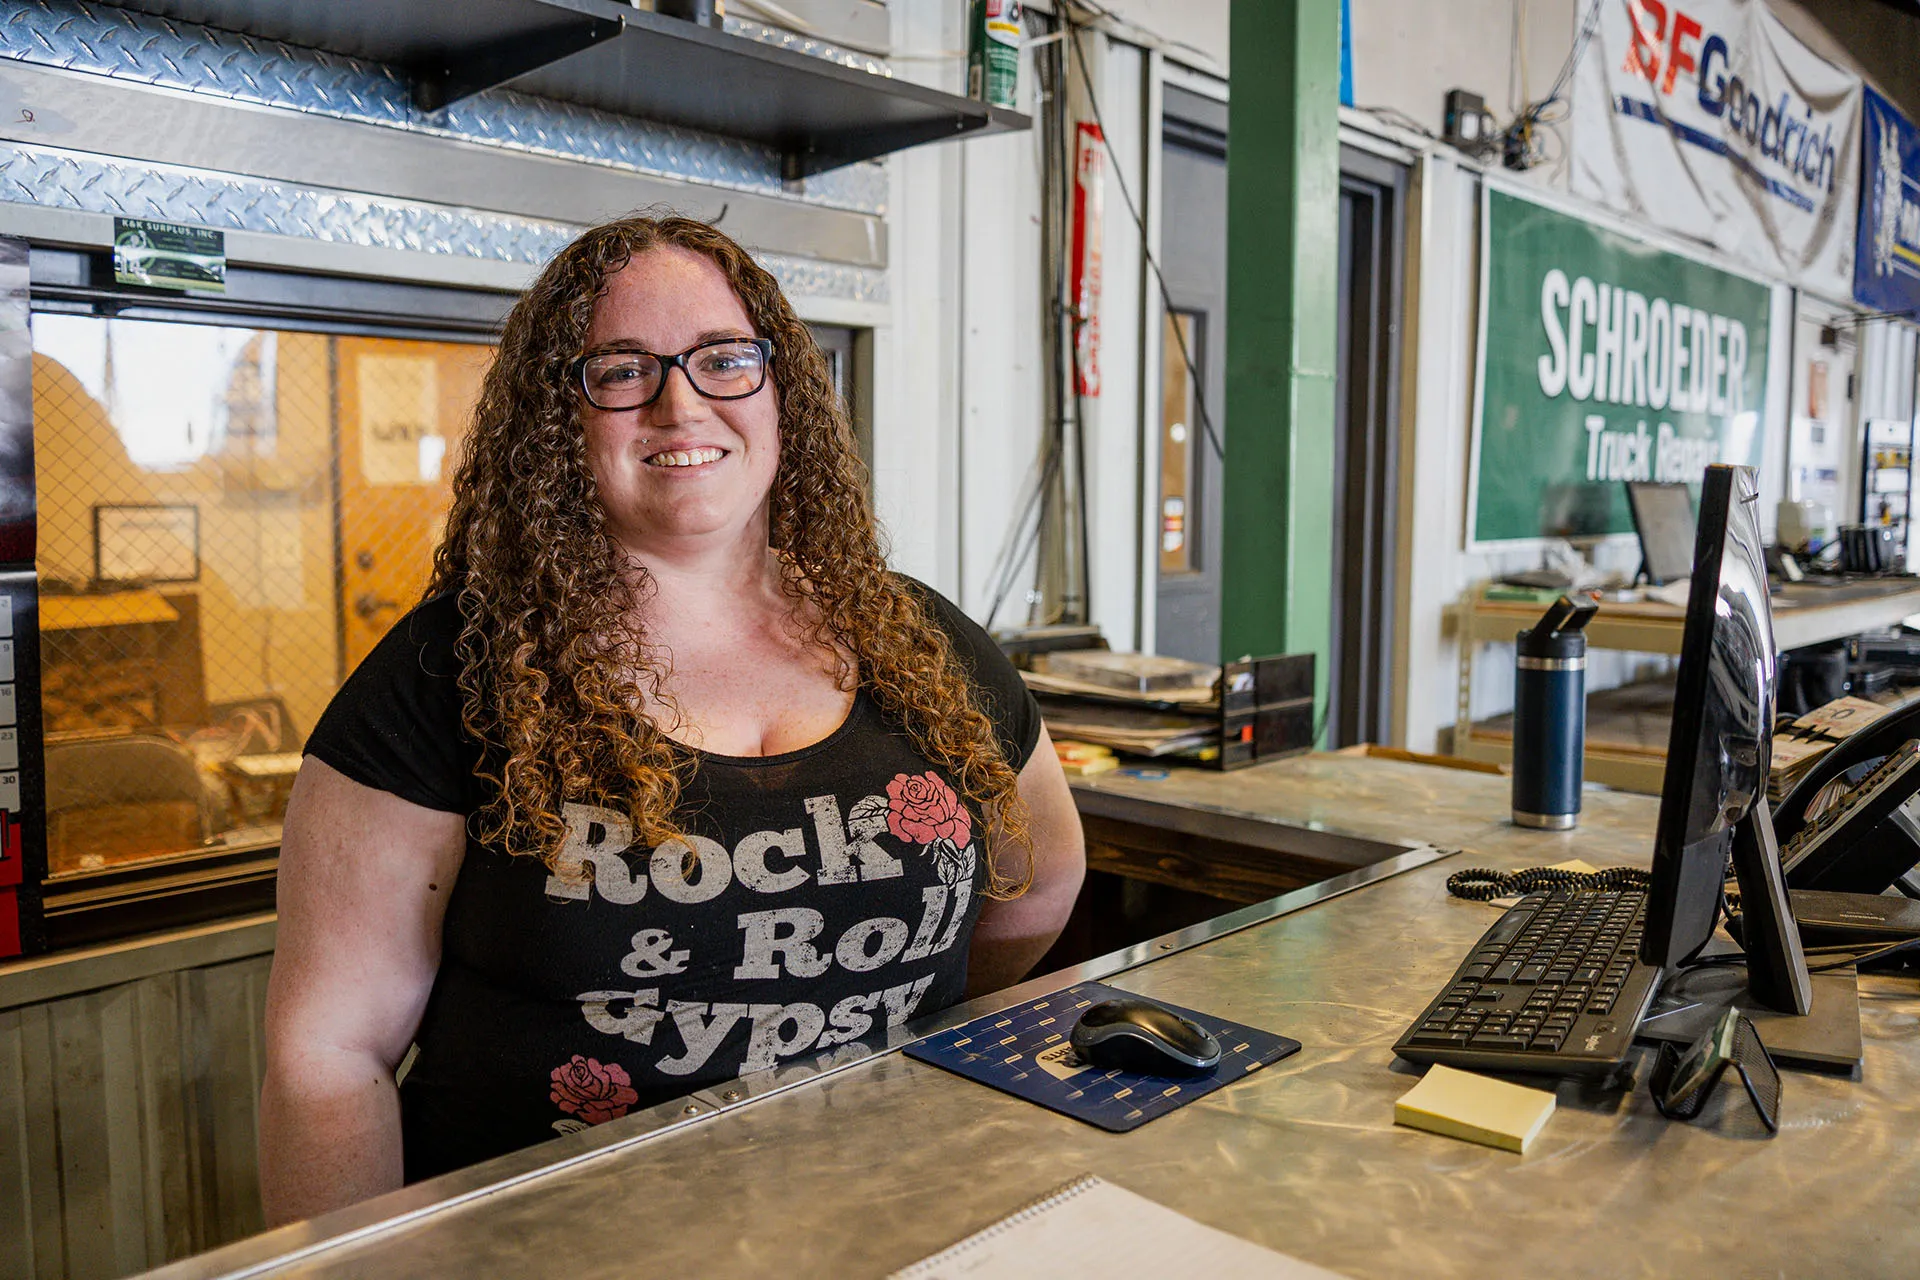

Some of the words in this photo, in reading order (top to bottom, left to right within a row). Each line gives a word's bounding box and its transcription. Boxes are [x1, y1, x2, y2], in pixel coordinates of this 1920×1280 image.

[1624, 0, 1835, 193] BFGoodrich
[197, 229, 218, 240] INC.
[1537, 268, 1748, 417] SCHROEDER
[1585, 414, 1652, 482] Truck
[1, 731, 13, 741] 23
[2, 775, 16, 785] 30
[545, 794, 904, 904] Rock
[620, 928, 690, 978] &
[733, 880, 974, 980] Roll
[576, 973, 935, 1076] Gypsy
